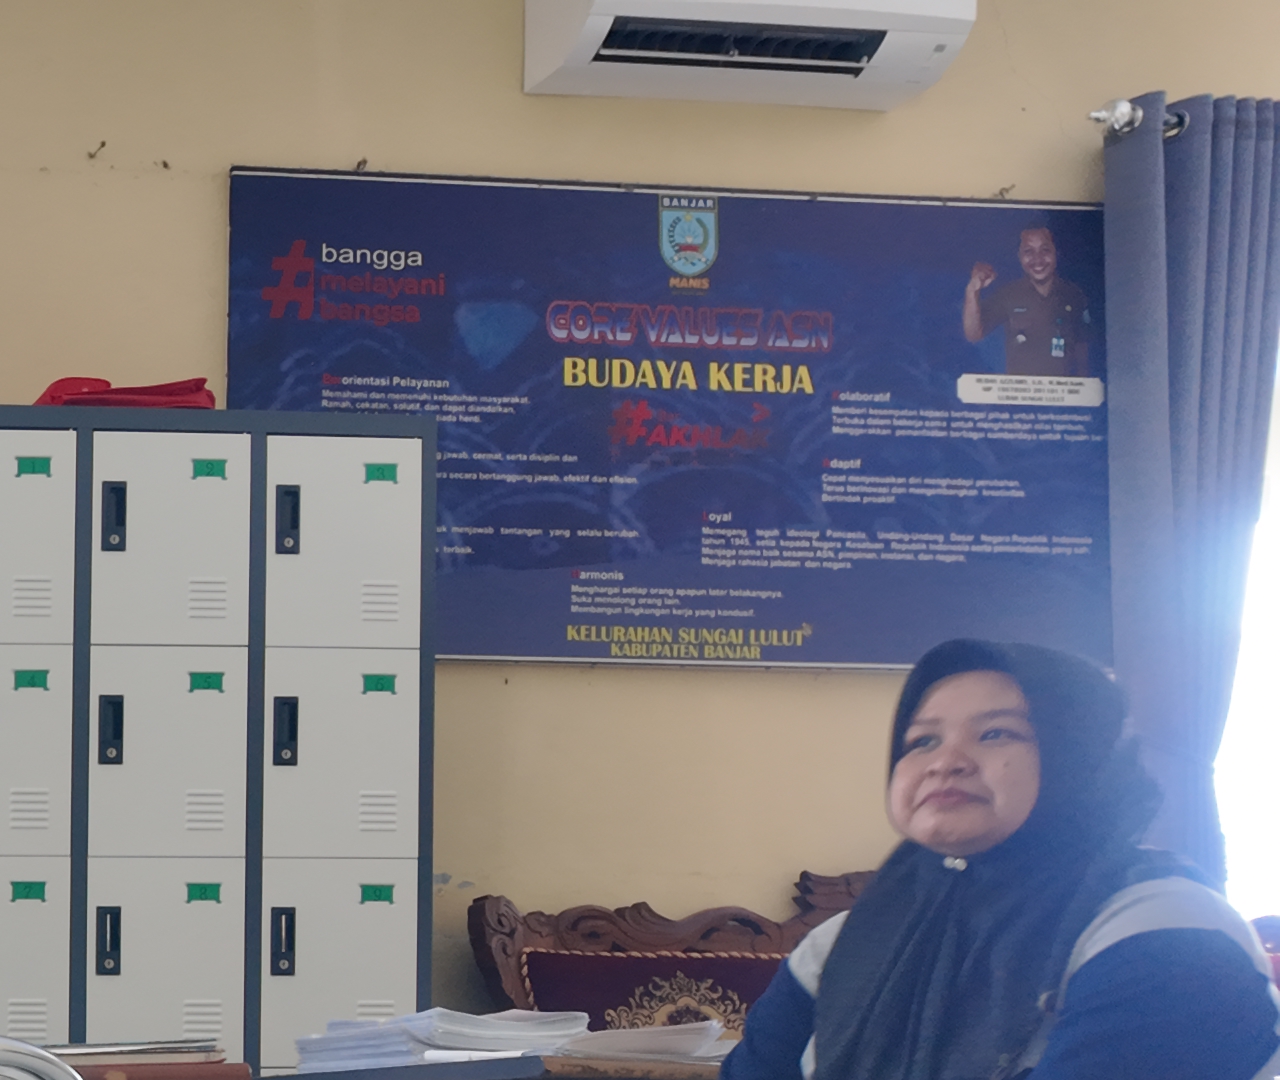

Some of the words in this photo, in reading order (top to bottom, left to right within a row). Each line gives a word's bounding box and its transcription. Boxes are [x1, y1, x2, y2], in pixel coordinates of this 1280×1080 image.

[662, 198, 714, 208] BANJAR
[321, 243, 424, 270] bangga
[320, 272, 446, 297] melayani
[669, 277, 710, 289] MANIS
[320, 300, 421, 326] bangsa
[546, 300, 638, 344] CORE
[640, 304, 763, 348] VALUES
[764, 310, 834, 352] ASN
[392, 376, 449, 390] Pelayanan
[563, 357, 697, 390] BUDAYA
[709, 362, 814, 394] KERJA
[702, 512, 731, 523] Loyal
[571, 569, 624, 581] Harmonis
[567, 625, 672, 643] KELURAHAN
[678, 627, 743, 645] SUNGAI
[750, 629, 803, 646] LULUT
[610, 642, 699, 658] KABUPATEN
[704, 645, 761, 660] BANJAR
